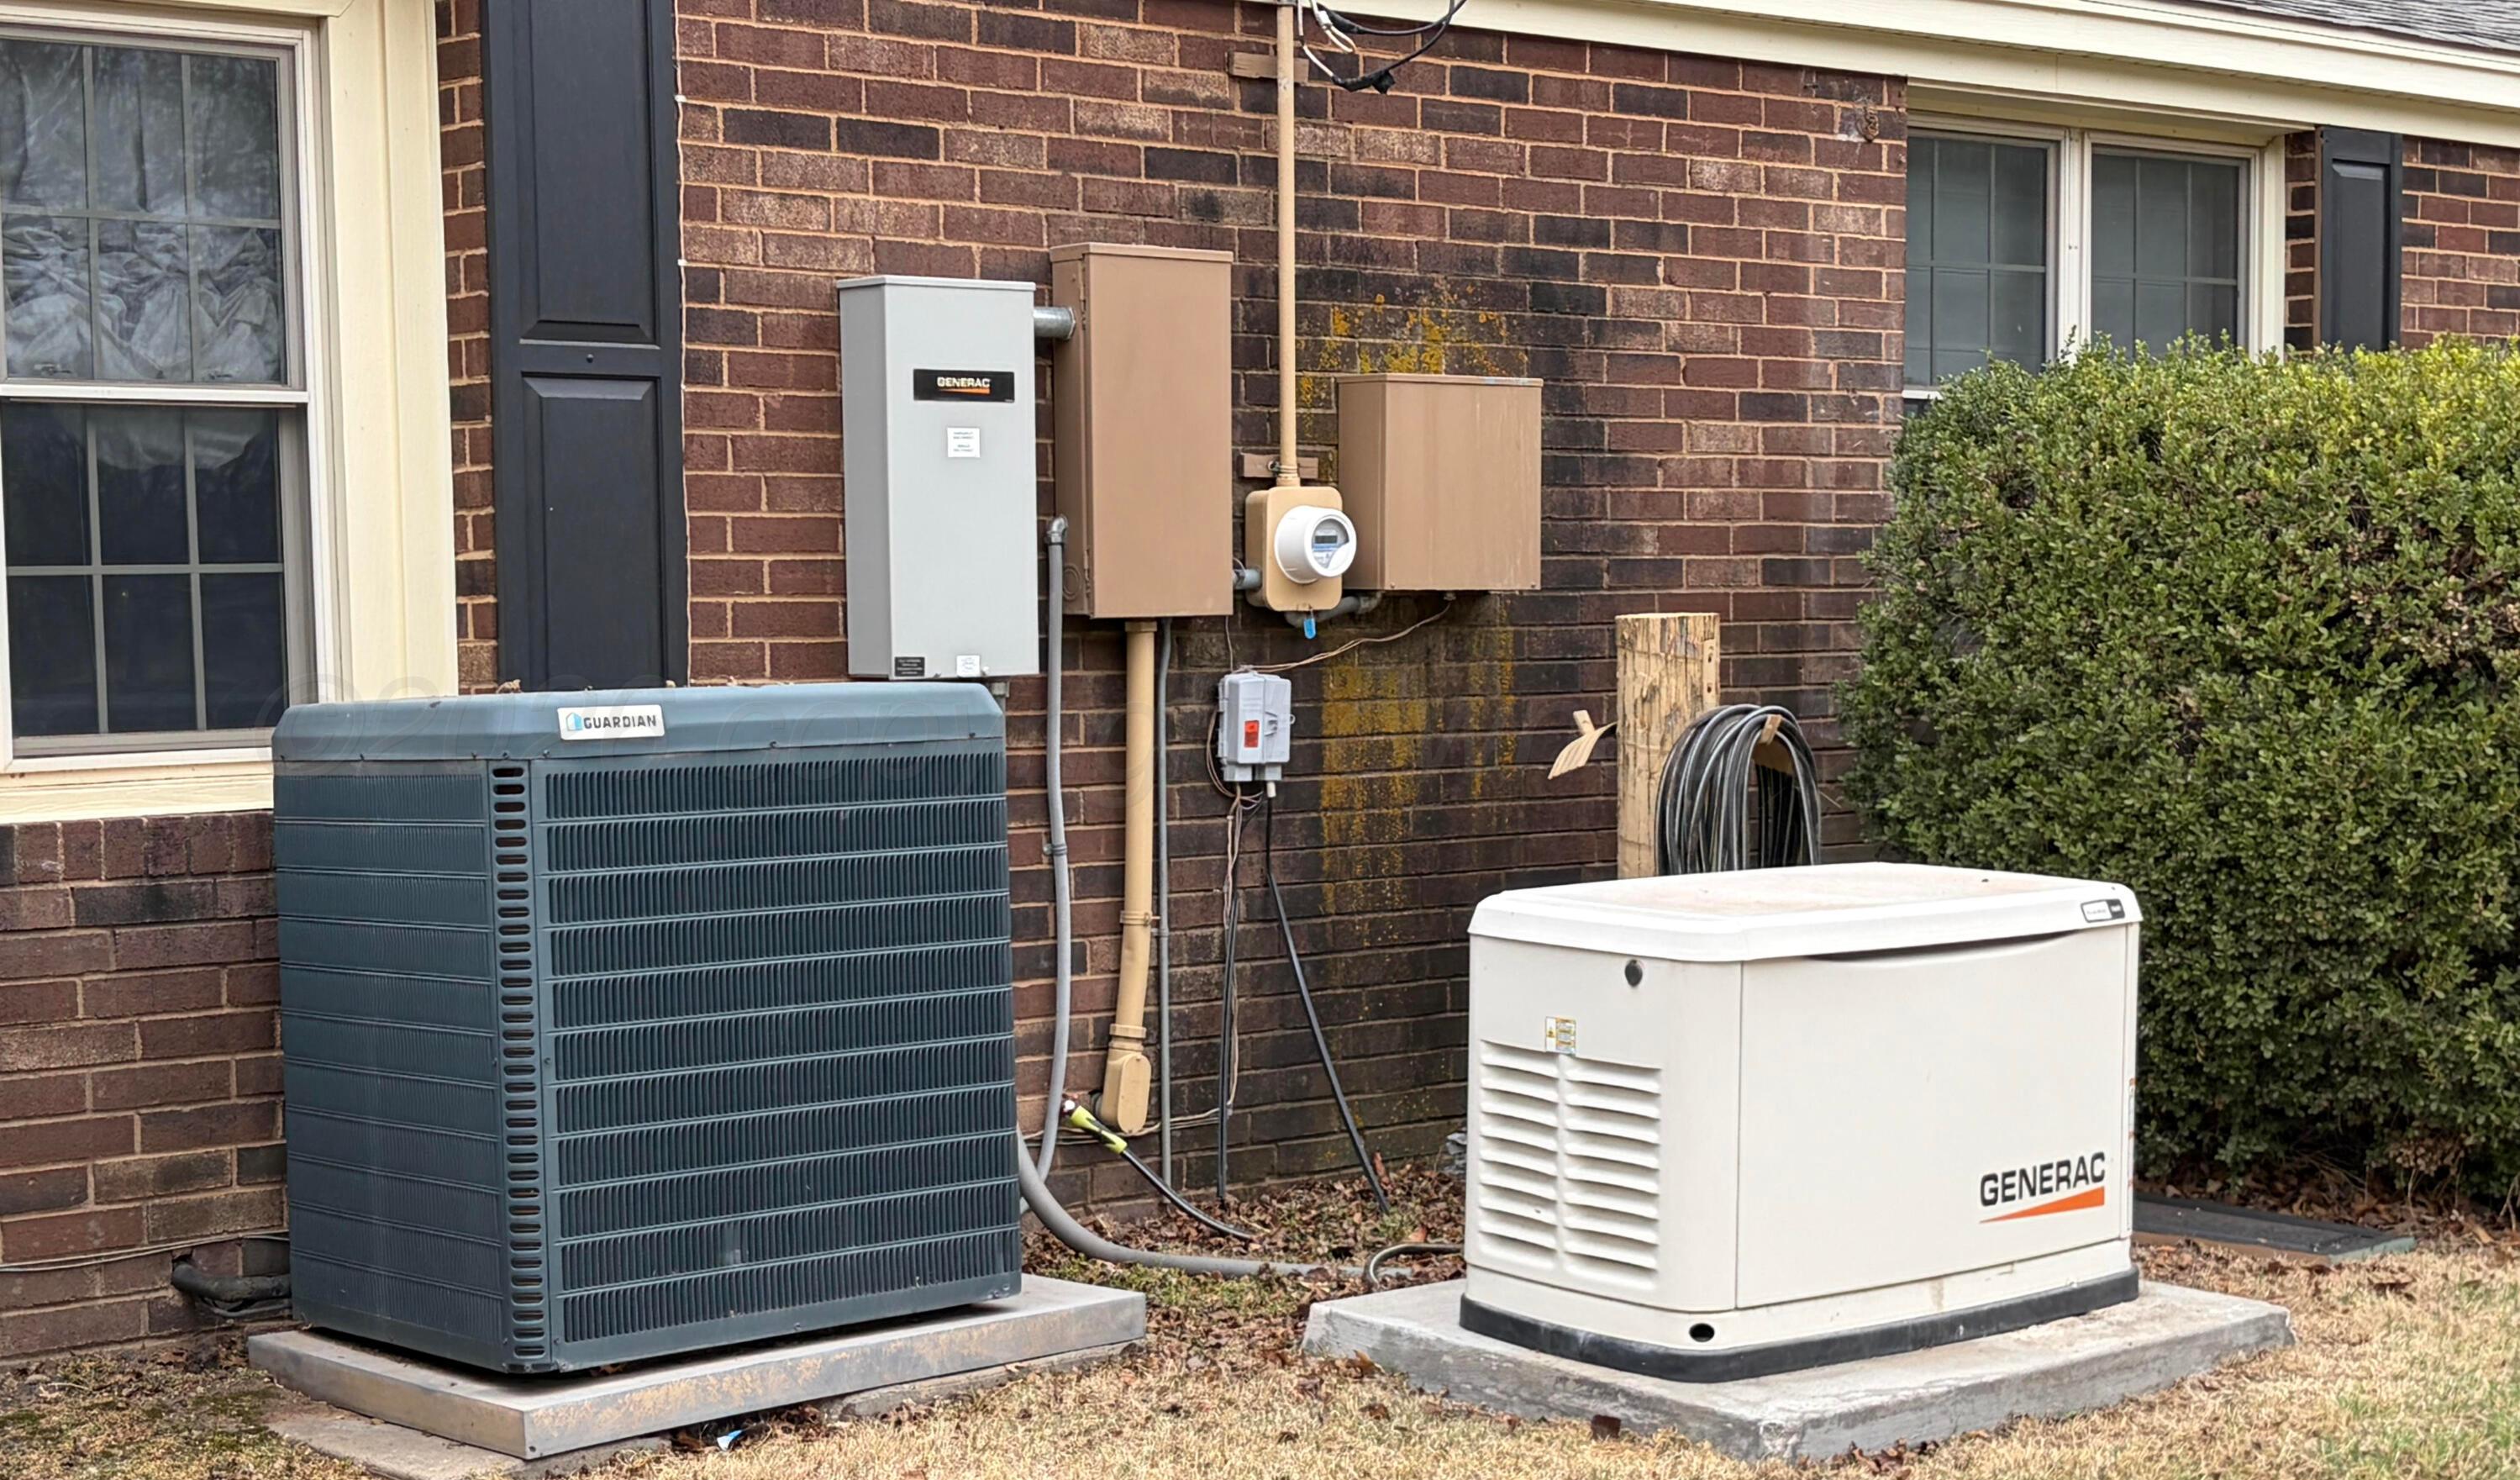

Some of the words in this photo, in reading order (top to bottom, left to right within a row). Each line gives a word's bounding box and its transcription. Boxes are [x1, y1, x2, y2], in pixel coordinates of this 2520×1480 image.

[937, 377, 991, 387] GENERAC
[583, 714, 656, 729] GUARDIAN
[1980, 1151, 2105, 1207] GENERAC
